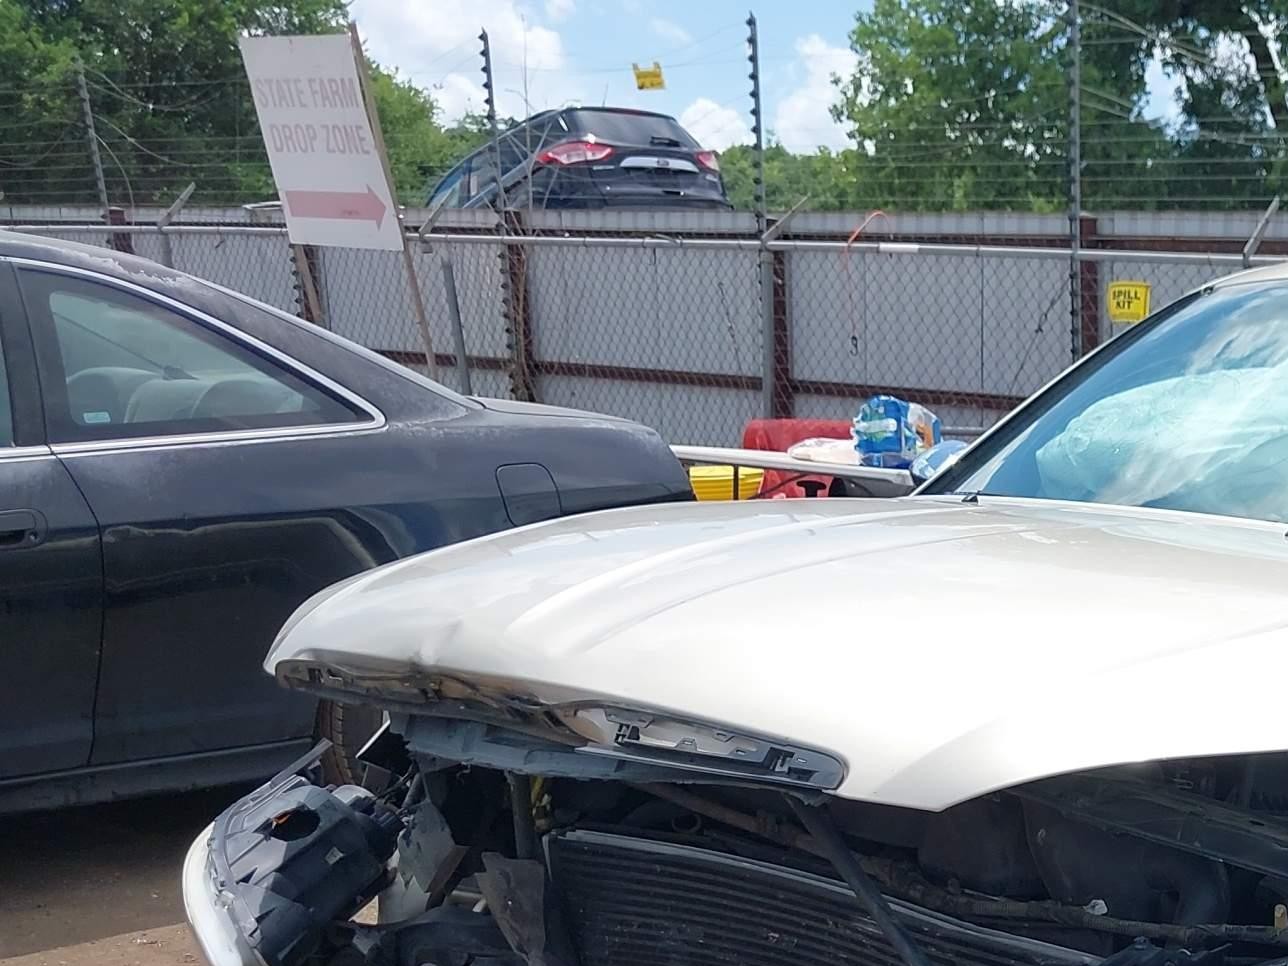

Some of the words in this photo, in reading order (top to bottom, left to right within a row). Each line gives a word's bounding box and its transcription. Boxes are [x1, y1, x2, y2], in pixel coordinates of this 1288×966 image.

[255, 78, 308, 108] STATE
[310, 78, 359, 108] FARM
[269, 124, 318, 153] DROP
[322, 125, 370, 155] ZONE
[1116, 300, 1132, 309] KIT
